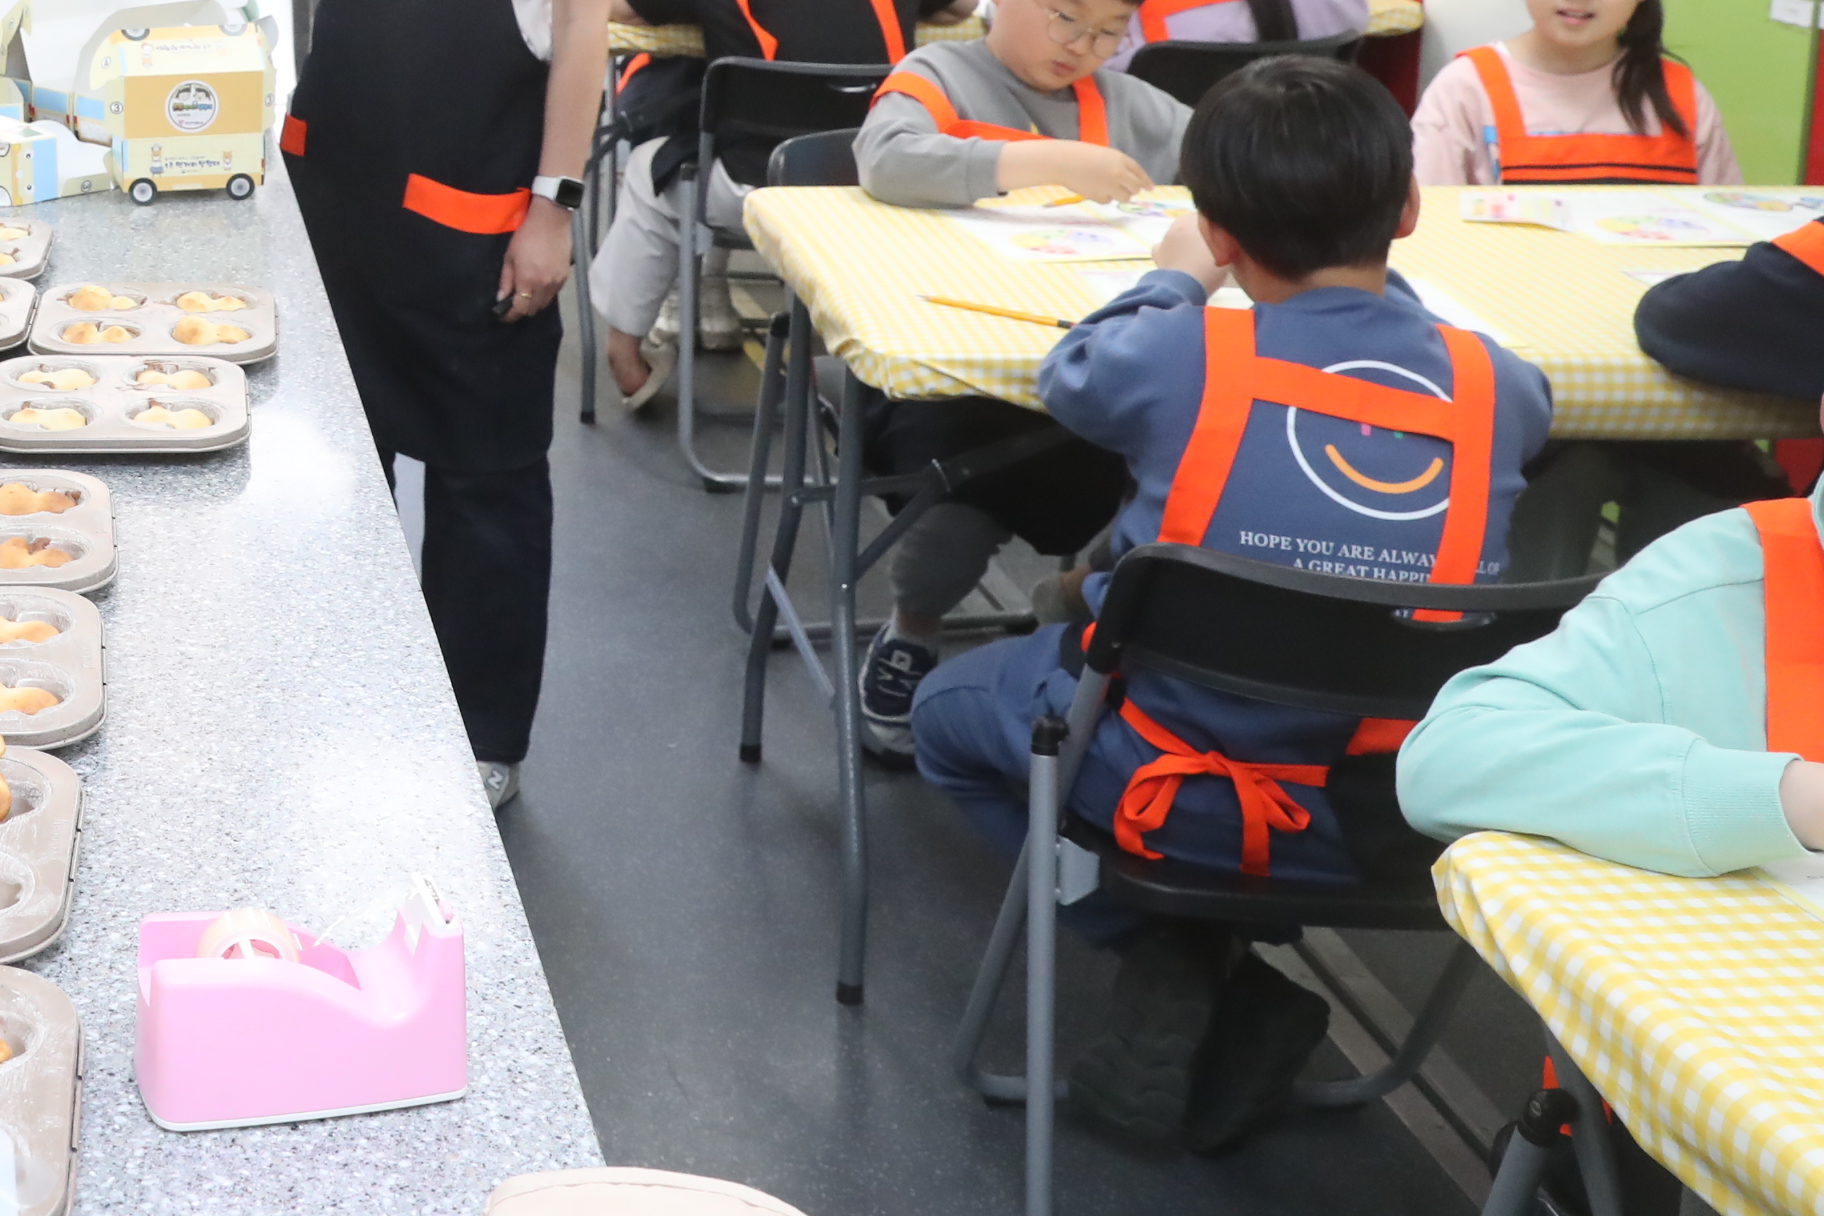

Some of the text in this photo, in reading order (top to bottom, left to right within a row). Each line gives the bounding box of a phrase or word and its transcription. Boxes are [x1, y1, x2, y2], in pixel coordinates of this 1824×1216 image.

[1239, 530, 1292, 551] HOPE
[1296, 538, 1335, 556] YOU
[1338, 543, 1375, 561] ARE
[1378, 549, 1437, 568] ALWAY
[1293, 559, 1431, 584] A GREAT HAPPI
